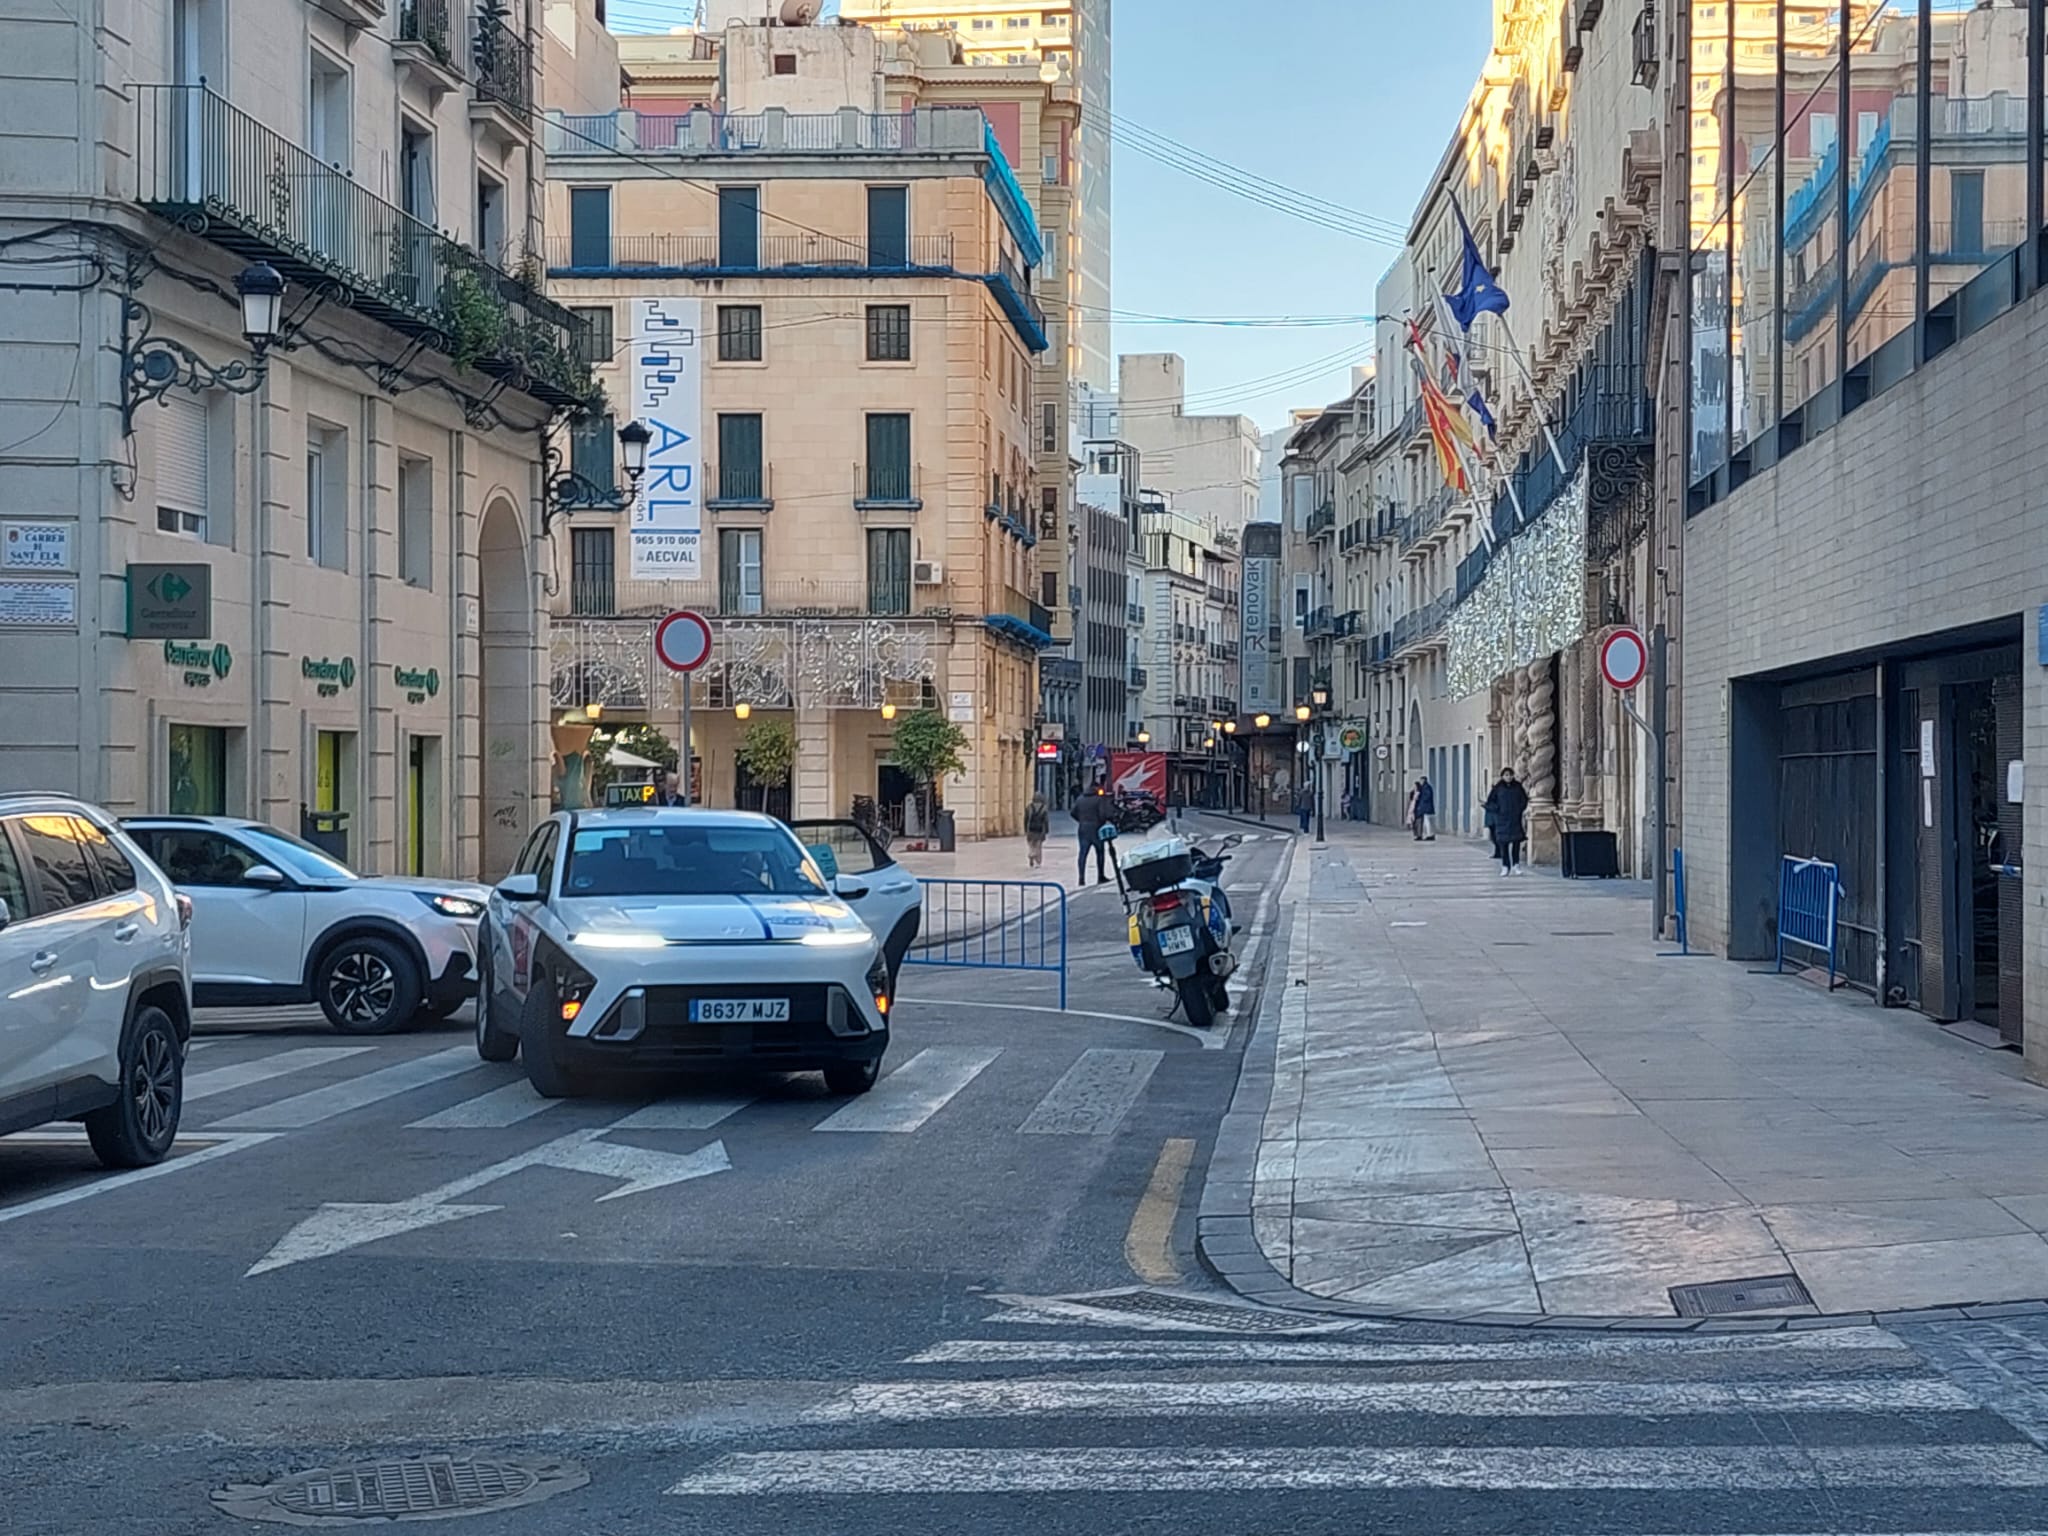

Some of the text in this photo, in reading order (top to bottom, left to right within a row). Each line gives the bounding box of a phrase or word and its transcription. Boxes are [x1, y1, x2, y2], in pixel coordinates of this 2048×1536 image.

[648, 417, 692, 521] ARL
[635, 535, 697, 546] 965 910 000
[646, 550, 696, 562] AECVAL
[702, 1002, 786, 1019] 8637 MJZ
